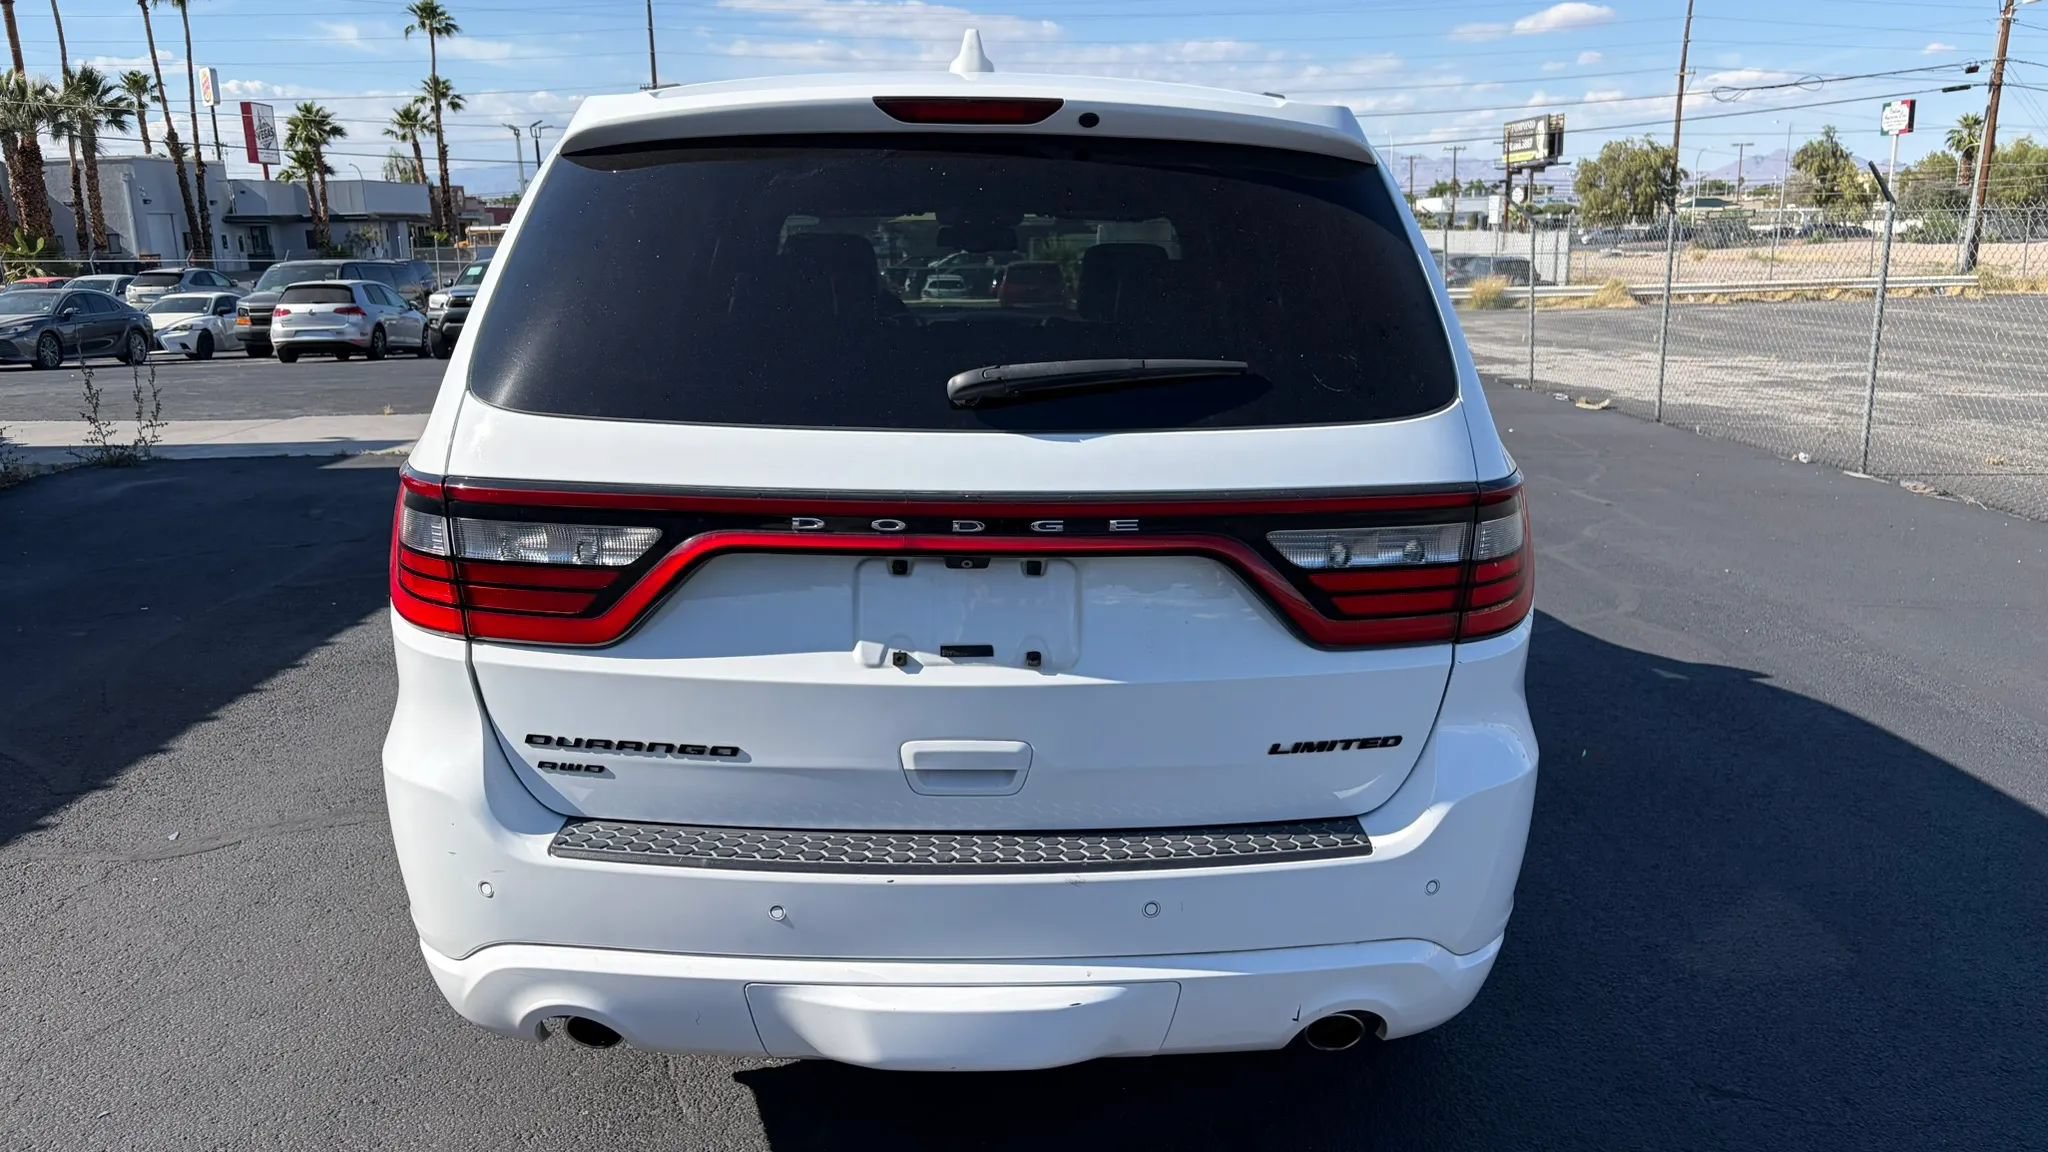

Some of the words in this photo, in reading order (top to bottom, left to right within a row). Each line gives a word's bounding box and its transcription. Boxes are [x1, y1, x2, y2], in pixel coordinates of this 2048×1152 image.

[256, 127, 275, 141] VEGAS
[792, 517, 1139, 532] DODGE
[525, 734, 741, 757] DURANGO
[1268, 735, 1403, 755] LIMITED
[538, 760, 606, 774] AWD
